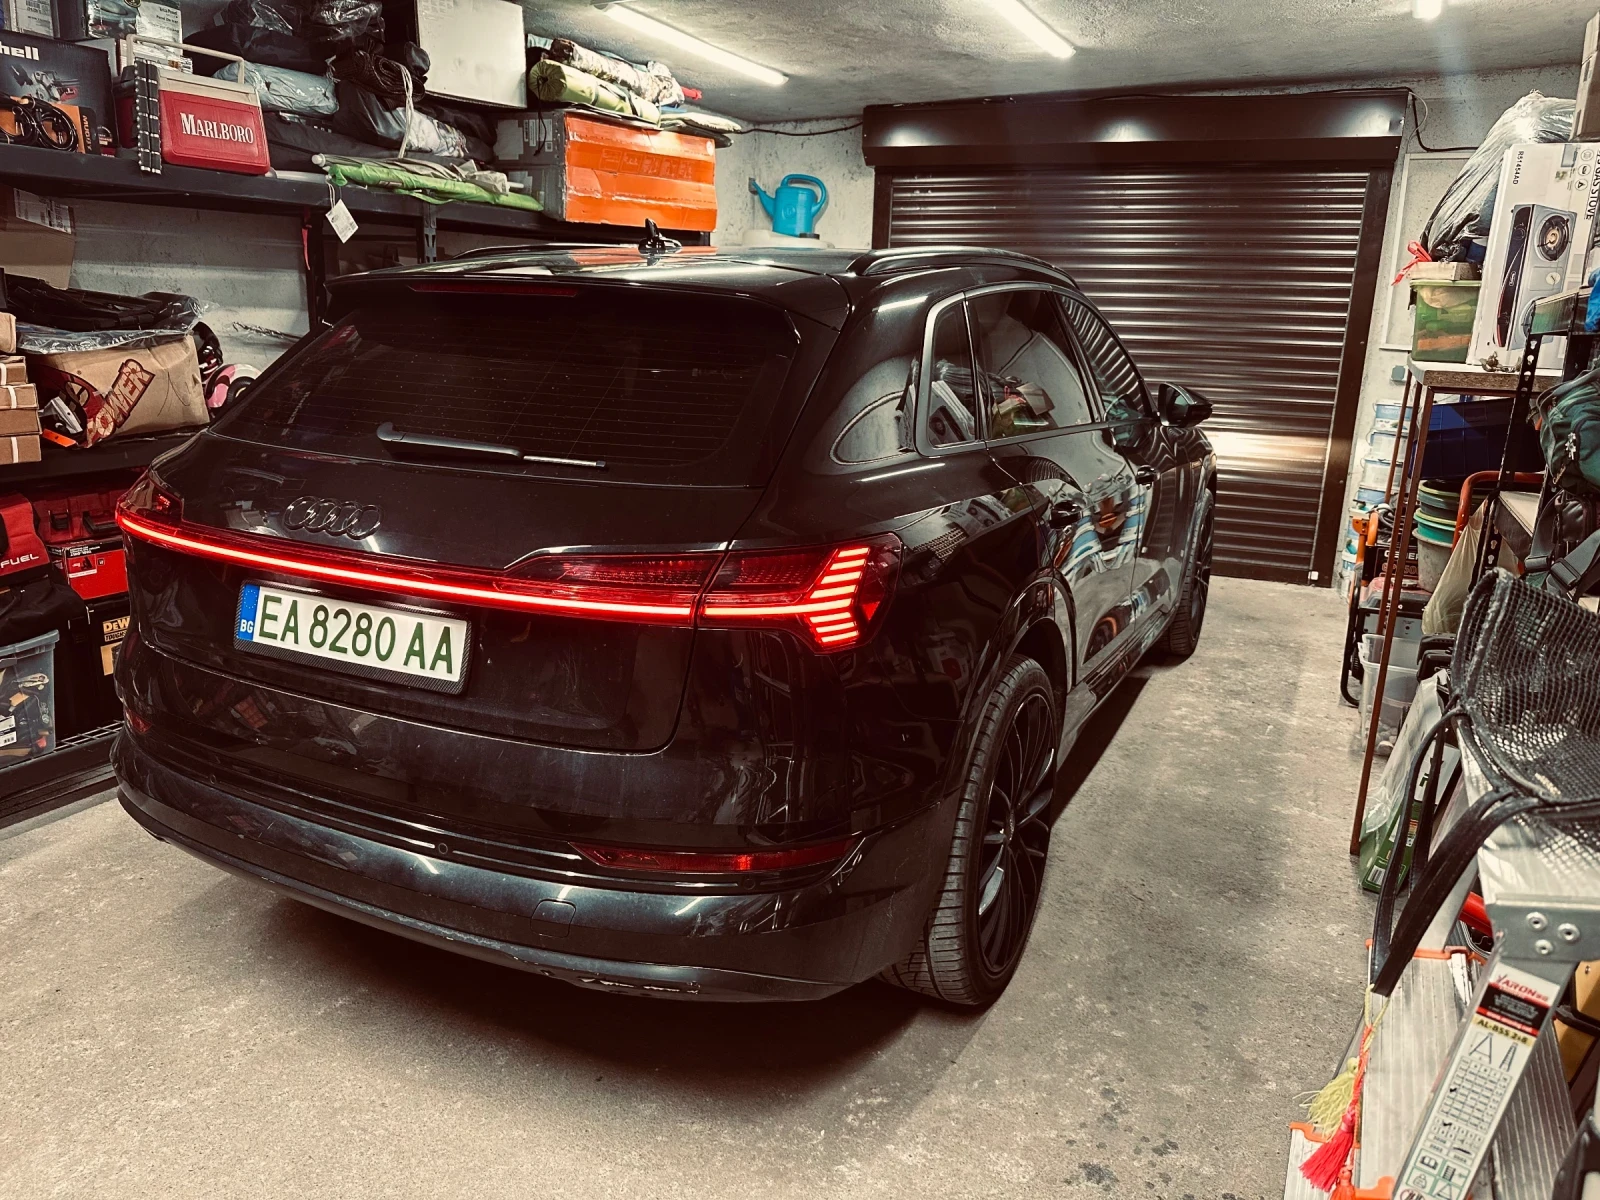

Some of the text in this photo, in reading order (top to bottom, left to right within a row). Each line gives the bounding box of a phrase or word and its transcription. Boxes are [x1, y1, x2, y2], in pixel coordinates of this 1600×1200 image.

[179, 112, 254, 144] MARLBORO
[0, 553, 39, 569] FUEL
[239, 619, 254, 634] BG
[258, 594, 453, 674] EA 8280 AA
